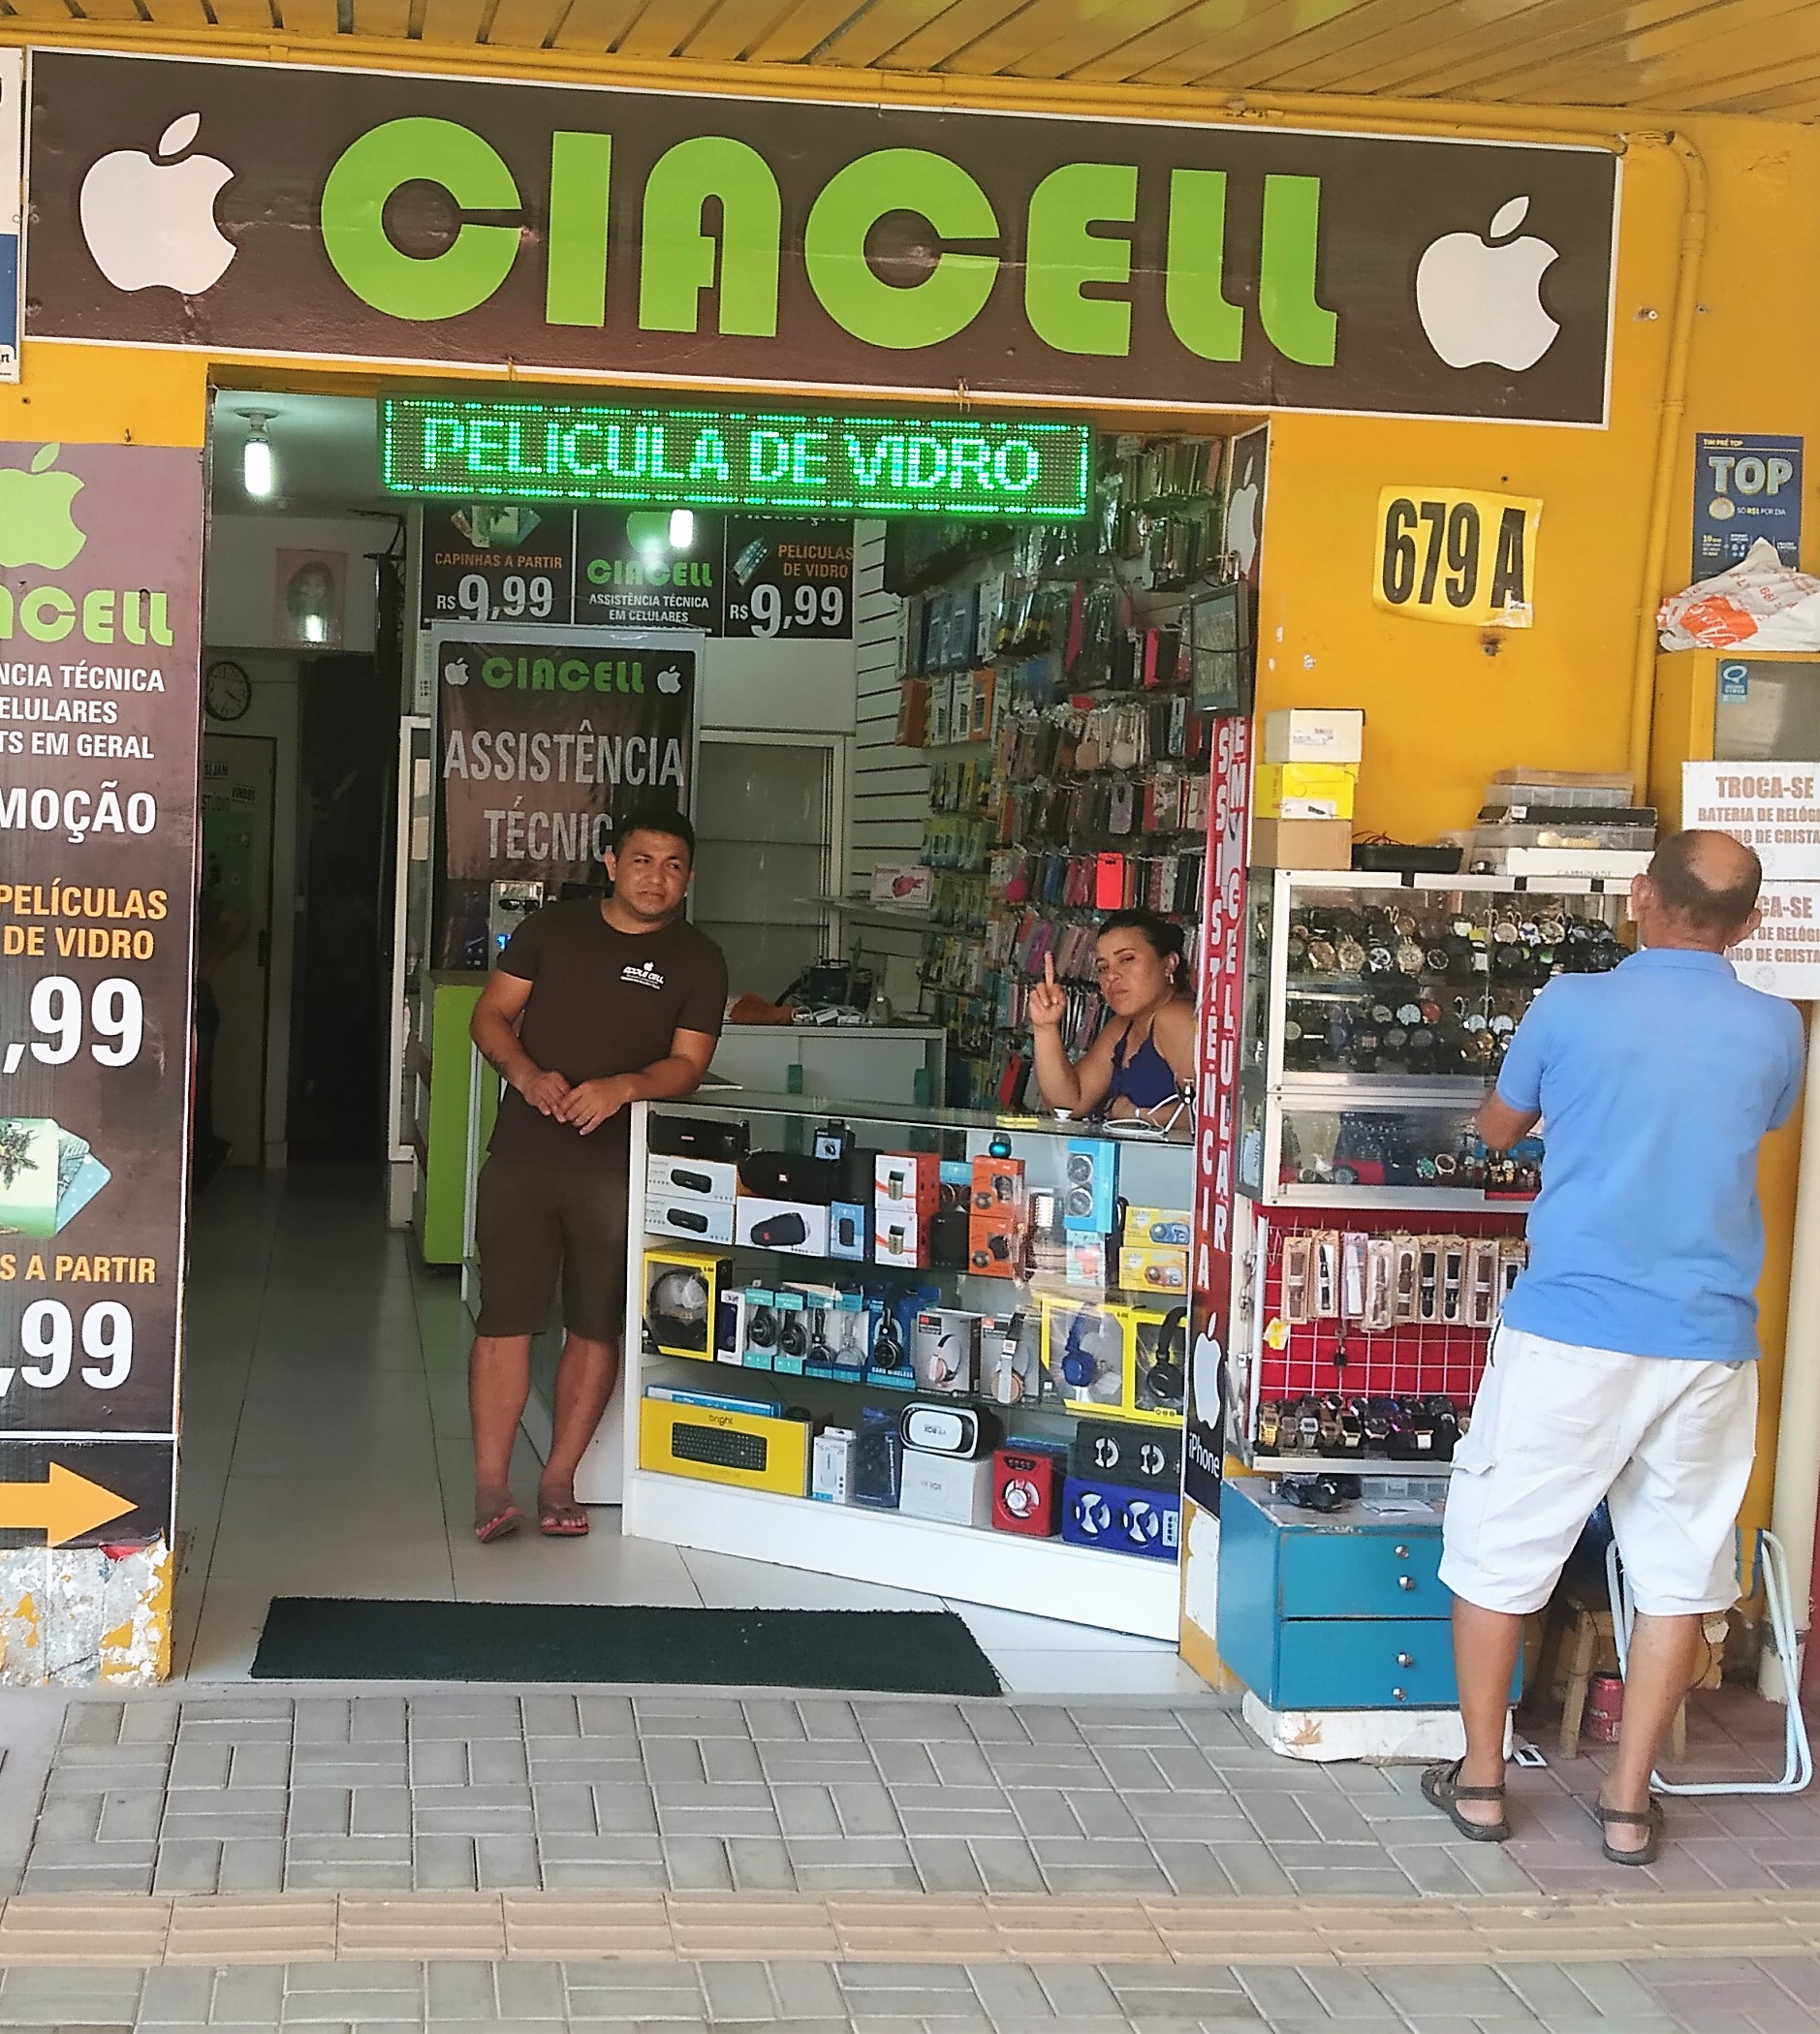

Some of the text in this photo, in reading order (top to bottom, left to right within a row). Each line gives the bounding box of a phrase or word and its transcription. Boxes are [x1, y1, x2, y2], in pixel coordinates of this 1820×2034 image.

[321, 116, 1337, 367] CIACELL
[424, 417, 1041, 492] PELICULA DE VIDRO
[1709, 455, 1793, 496] TOP
[435, 552, 563, 570] CAPINHAS A PARTIR
[1382, 498, 1526, 610] 679 A
[586, 558, 712, 587] CIACELL
[783, 563, 848, 579] DE VIDRO
[458, 574, 553, 621] 9,99
[589, 591, 709, 609] ASSISTÊNCIA TÉCNICA
[750, 583, 844, 638] 9,99
[609, 610, 689, 623] EM CELULARES
[60, 660, 166, 693] TÉCNICA
[482, 656, 645, 694] CIACELL
[0, 696, 118, 725] ELULARES
[31, 732, 69, 756] EM
[77, 734, 155, 760] GERAL
[443, 718, 685, 787] ASSISTÊNCIA
[1715, 775, 1814, 799] TROCA-SE
[484, 795, 613, 862] TÉCNIC
[1698, 806, 1754, 823] BATERIA
[1757, 807, 1773, 822] DE
[1755, 829, 1772, 844] DE
[0, 877, 168, 920] PELÍCULAS
[1756, 894, 1813, 919] CA-SE
[4, 925, 155, 959] DE VIDRO
[1757, 926, 1774, 941] DE
[1756, 948, 1773, 962] DE
[1197, 727, 1229, 1291] SSISTÊNCIA
[25, 1254, 47, 1281] A
[55, 1255, 156, 1284] PARTIR
[1188, 1431, 1221, 1479] iPhone
